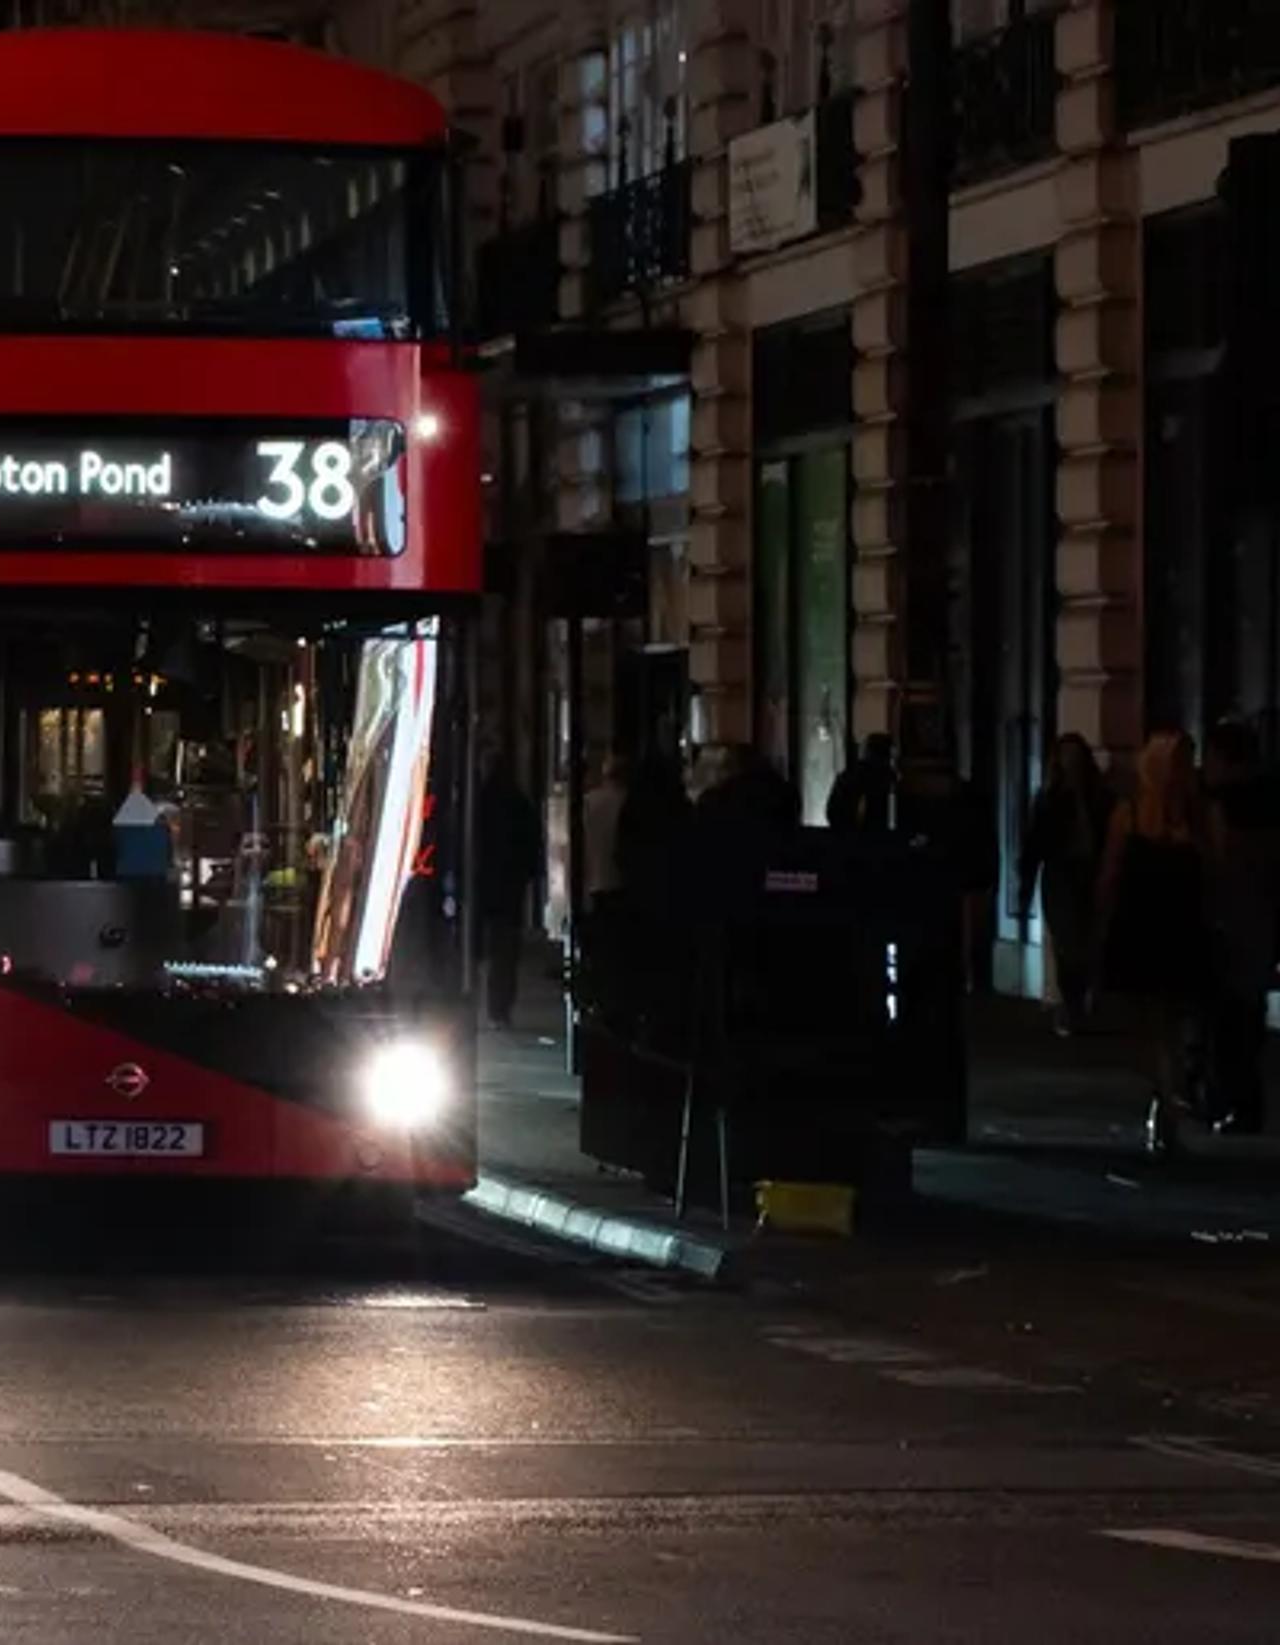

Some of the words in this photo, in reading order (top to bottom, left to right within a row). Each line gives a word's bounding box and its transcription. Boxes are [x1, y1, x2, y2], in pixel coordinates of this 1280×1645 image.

[80, 450, 172, 496] Pond
[256, 440, 354, 520] 38
[66, 1125, 117, 1149] LTZ
[126, 1126, 185, 1150] 1822
